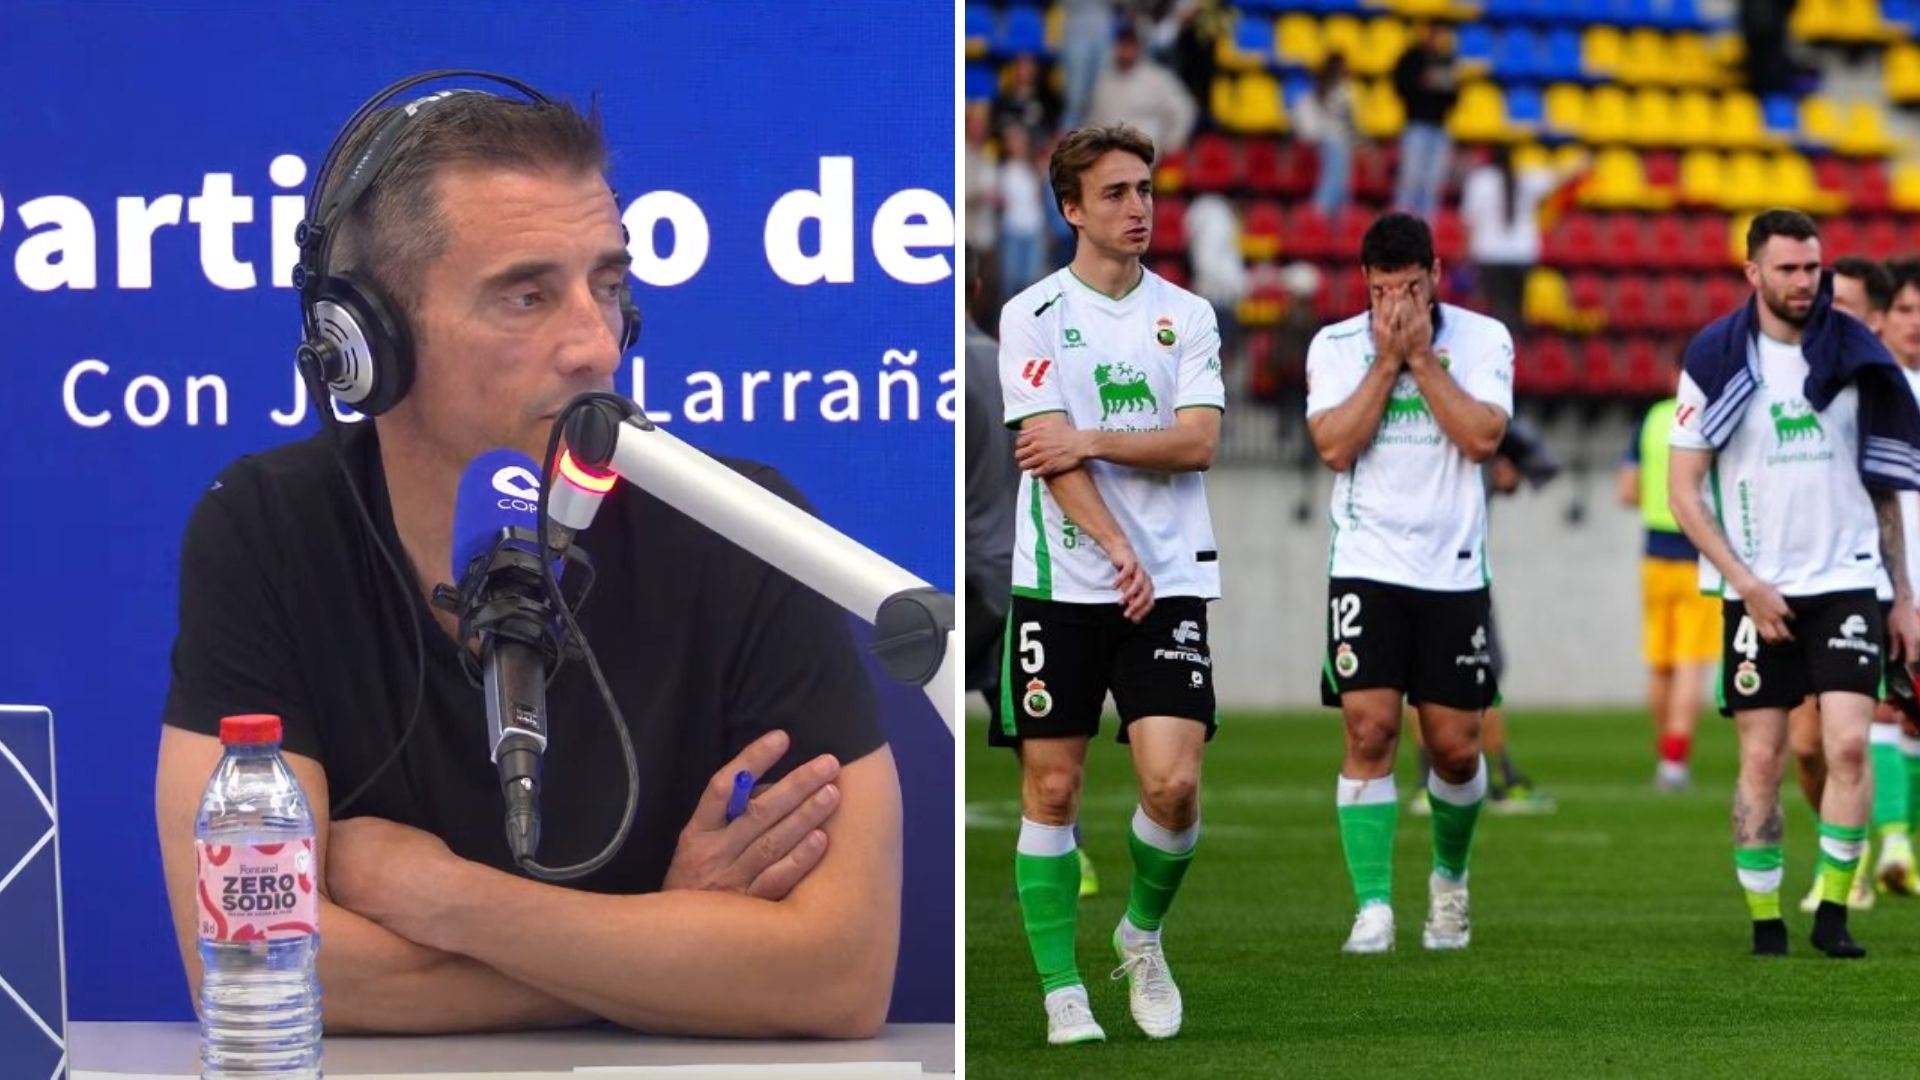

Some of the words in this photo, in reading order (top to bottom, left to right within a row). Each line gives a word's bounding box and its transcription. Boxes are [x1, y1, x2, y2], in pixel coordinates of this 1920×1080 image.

[62, 359, 228, 427] Con
[497, 499, 538, 513] COP
[1331, 593, 1362, 641] 12
[1733, 615, 1758, 660] 4
[1020, 621, 1045, 673] 5
[222, 874, 295, 894] ZERO
[222, 892, 297, 912] SODIO
